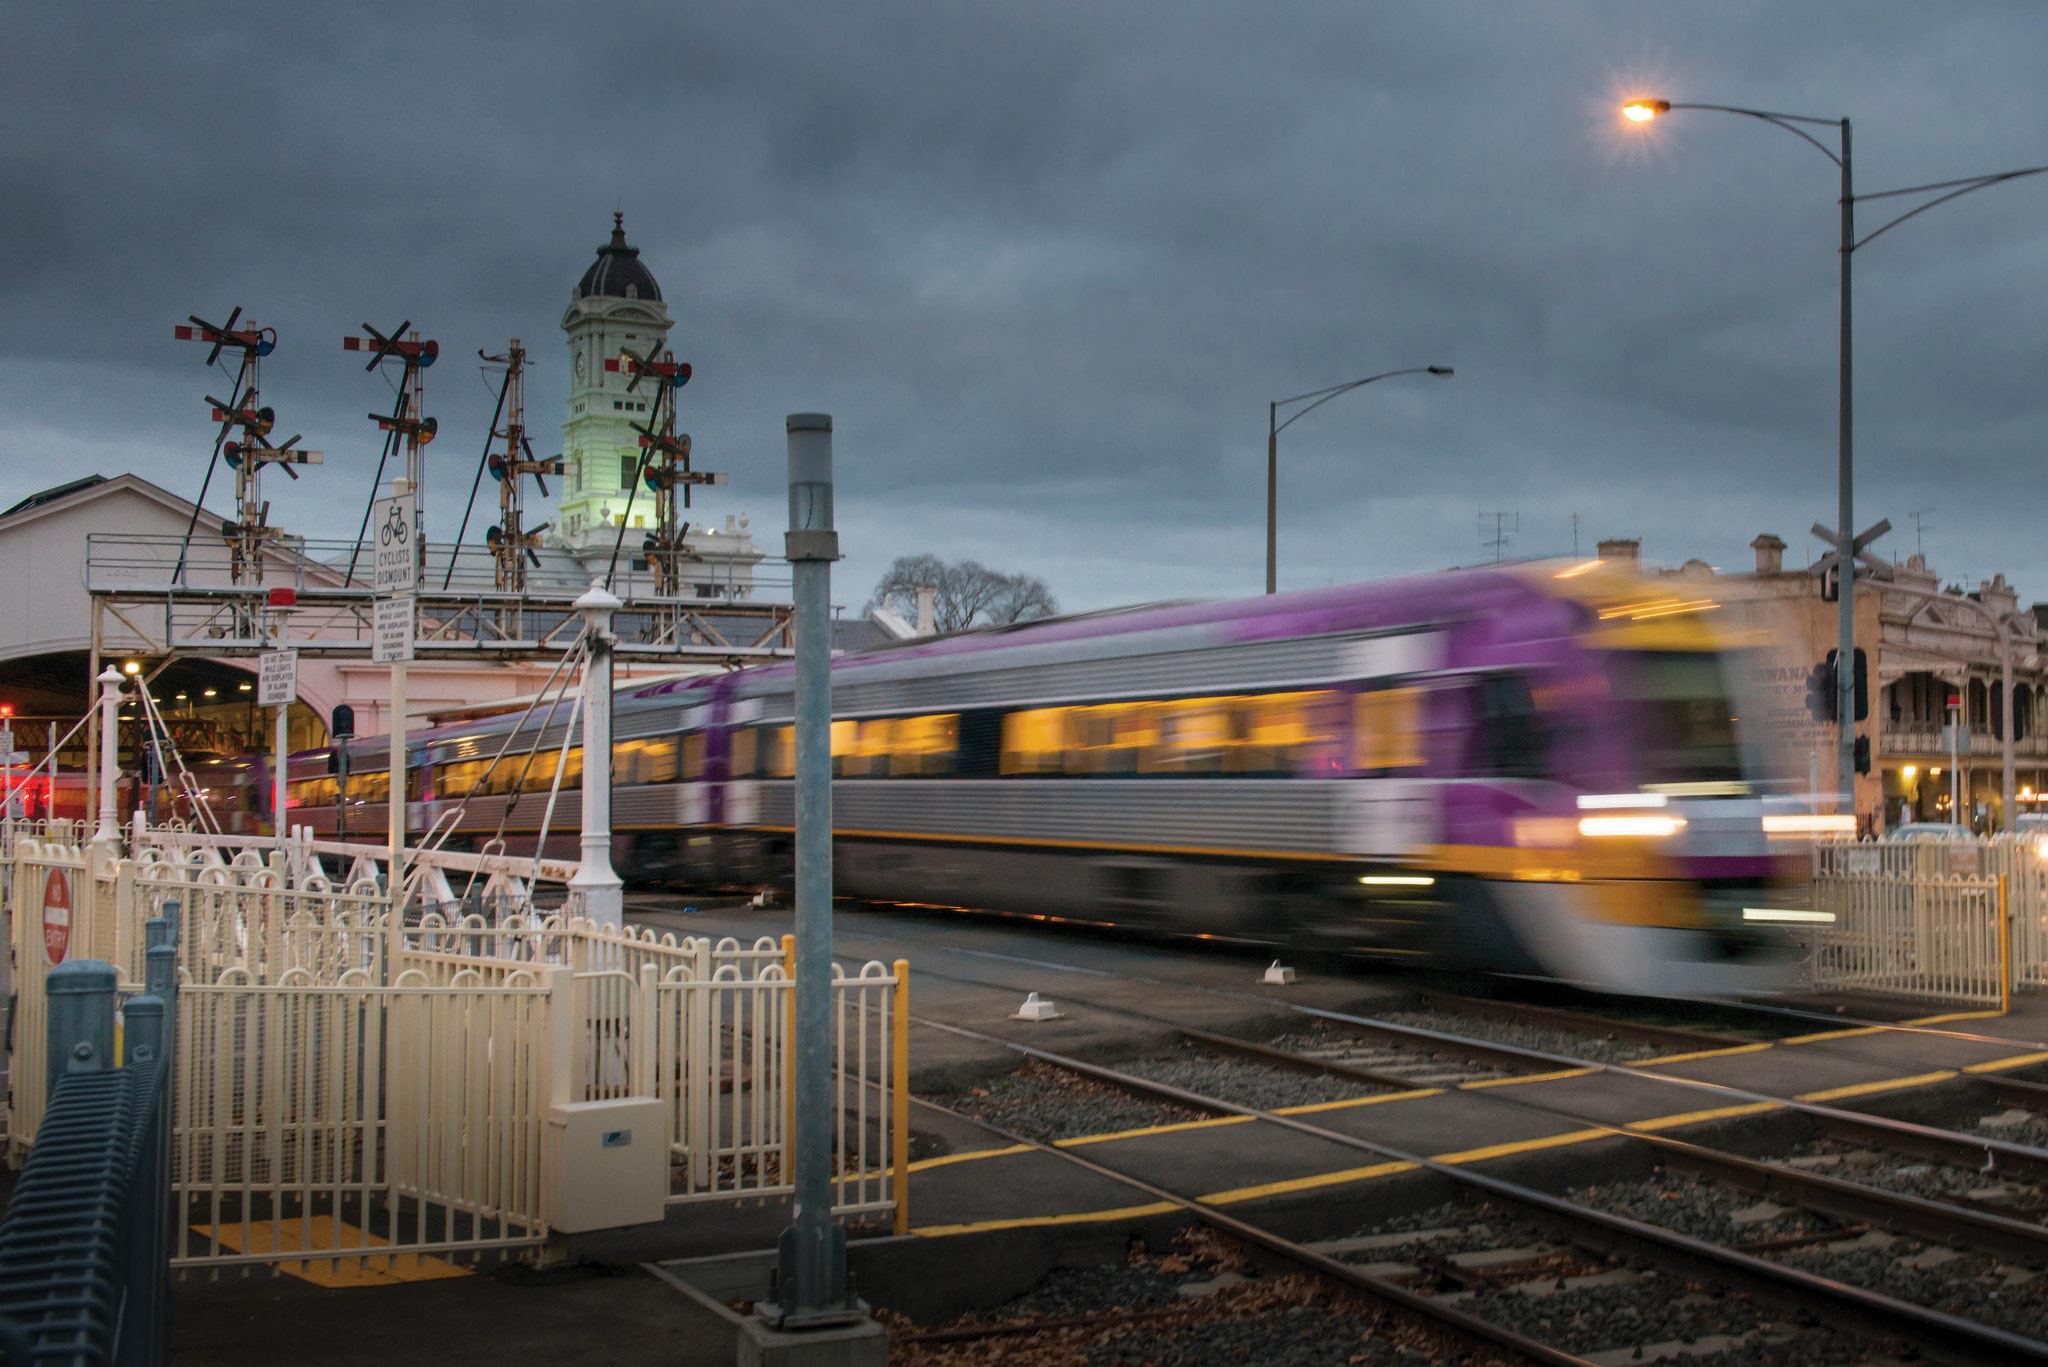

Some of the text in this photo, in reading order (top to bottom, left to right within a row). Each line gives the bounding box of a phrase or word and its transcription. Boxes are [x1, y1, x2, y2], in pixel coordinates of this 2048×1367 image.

[379, 549, 410, 567] CYCLISTS
[378, 567, 411, 585] DISMOUNT
[379, 610, 408, 620] WHILE LIGHTS
[378, 620, 409, 631] ARE DISPLAYED
[390, 631, 404, 639] ALARM
[382, 641, 404, 650] SOUNDING
[276, 663, 291, 672] LIGHTS
[262, 672, 294, 682] ARE DISPLAYED
[273, 682, 288, 690] ALARM
[52, 883, 62, 902] NO
[46, 928, 66, 949] ENTRY
